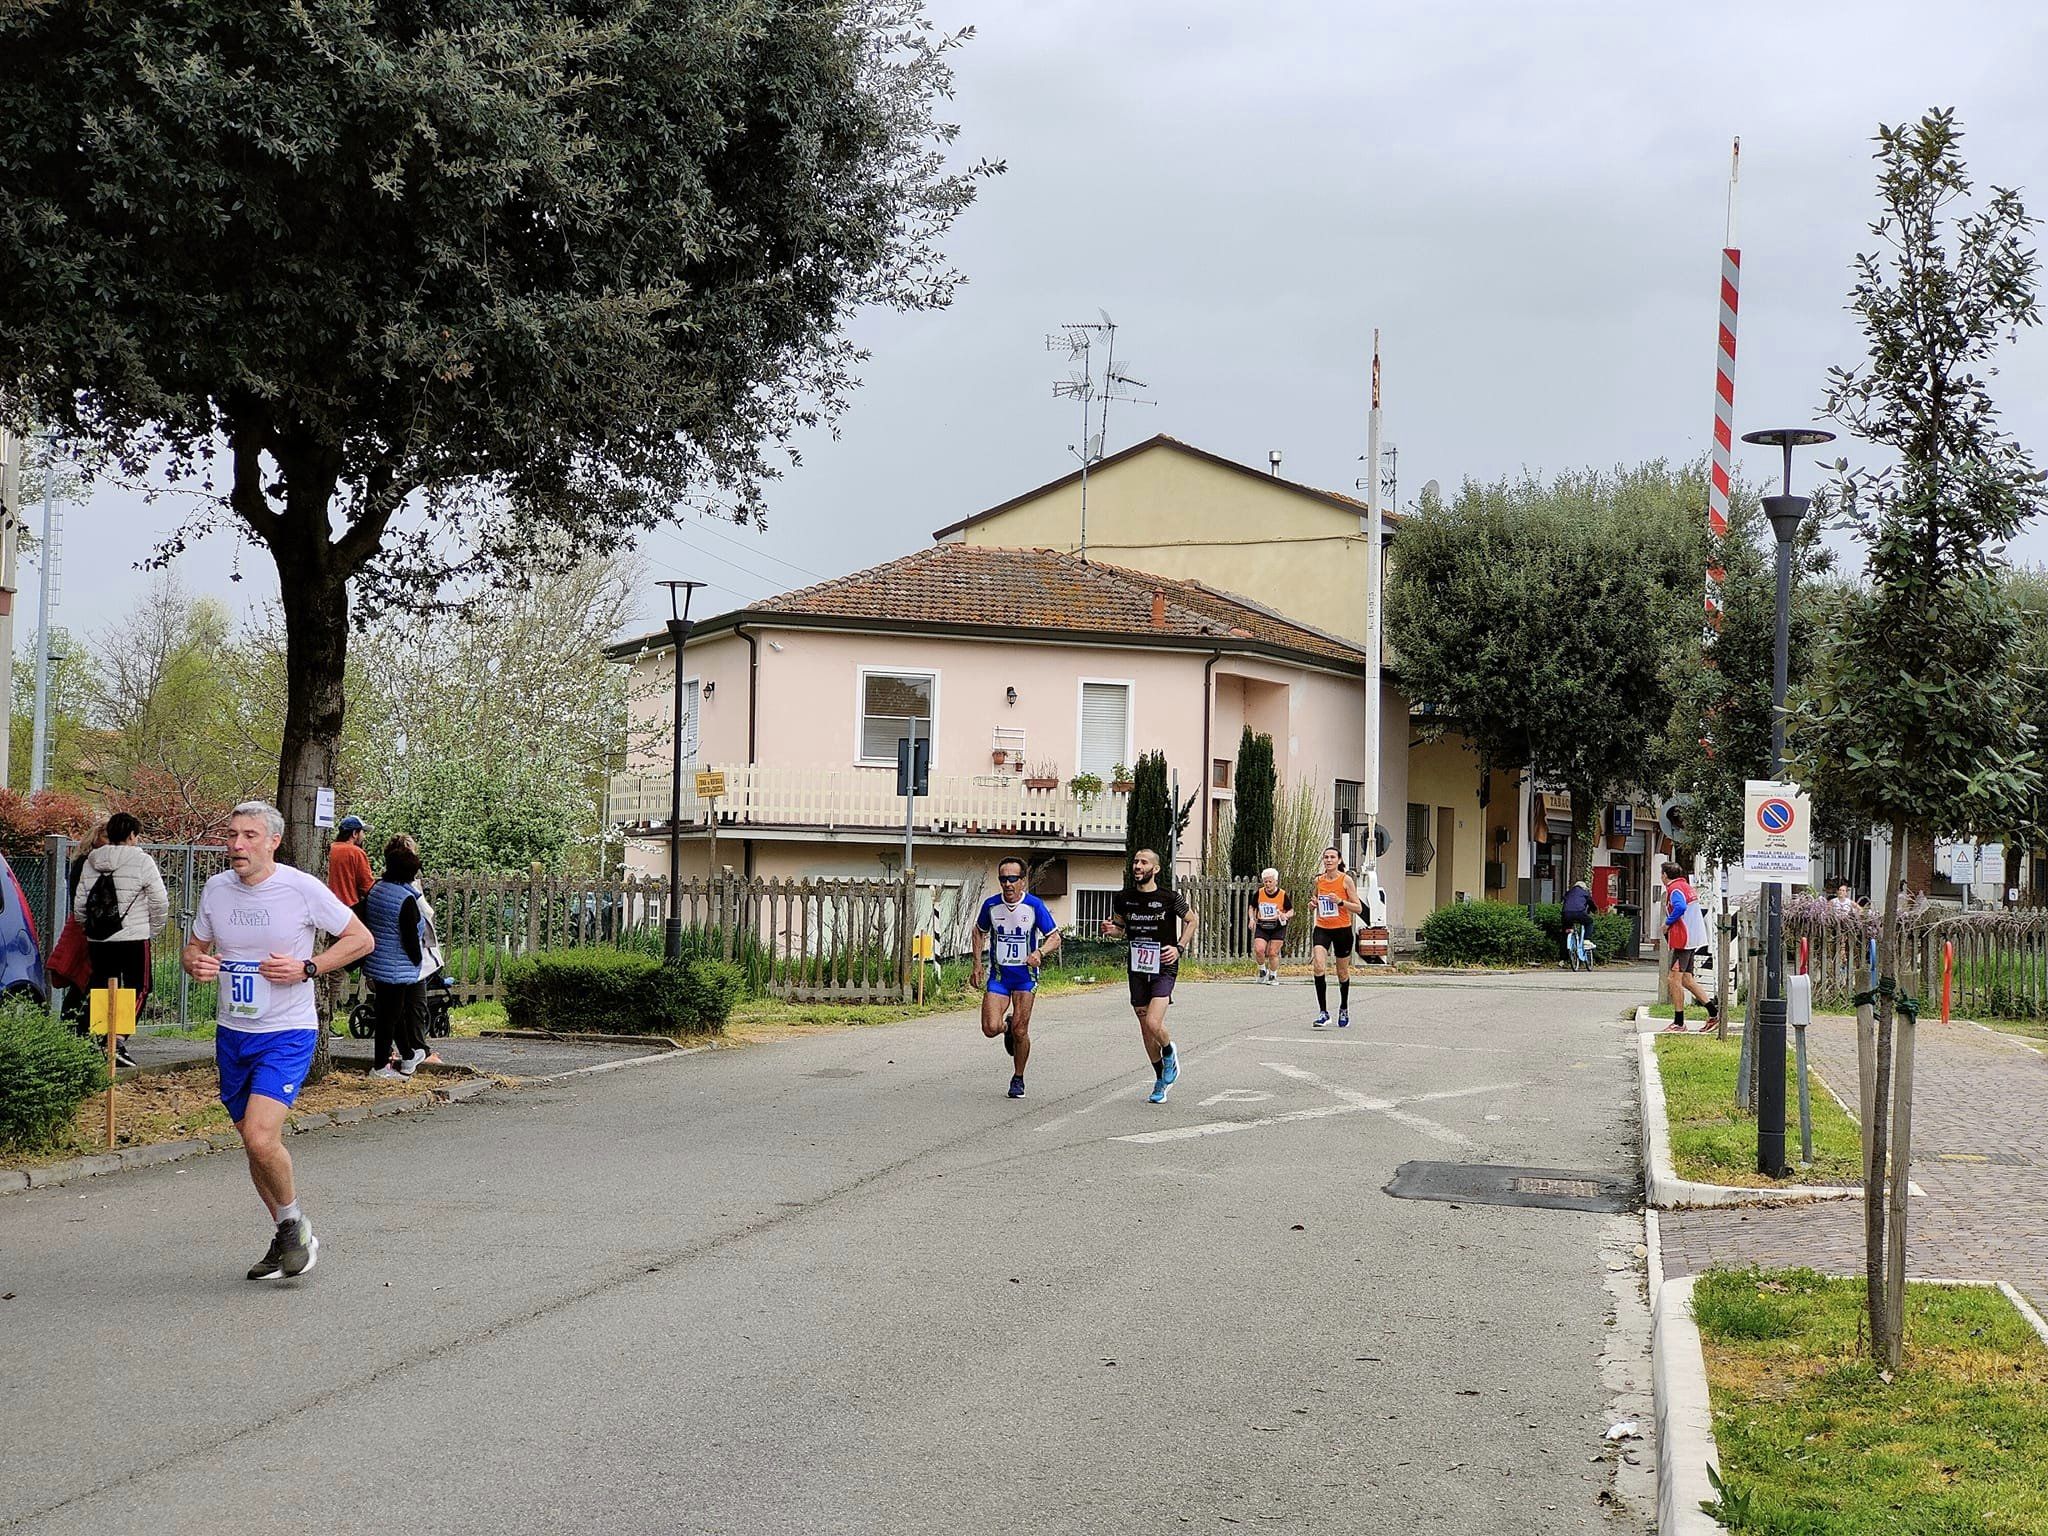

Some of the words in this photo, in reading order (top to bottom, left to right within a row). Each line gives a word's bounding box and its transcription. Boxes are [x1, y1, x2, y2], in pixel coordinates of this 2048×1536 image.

[1615, 804, 1631, 827] T
[1006, 943, 1019, 958] 79
[1137, 949, 1155, 965] 227
[231, 974, 254, 1004] 50
